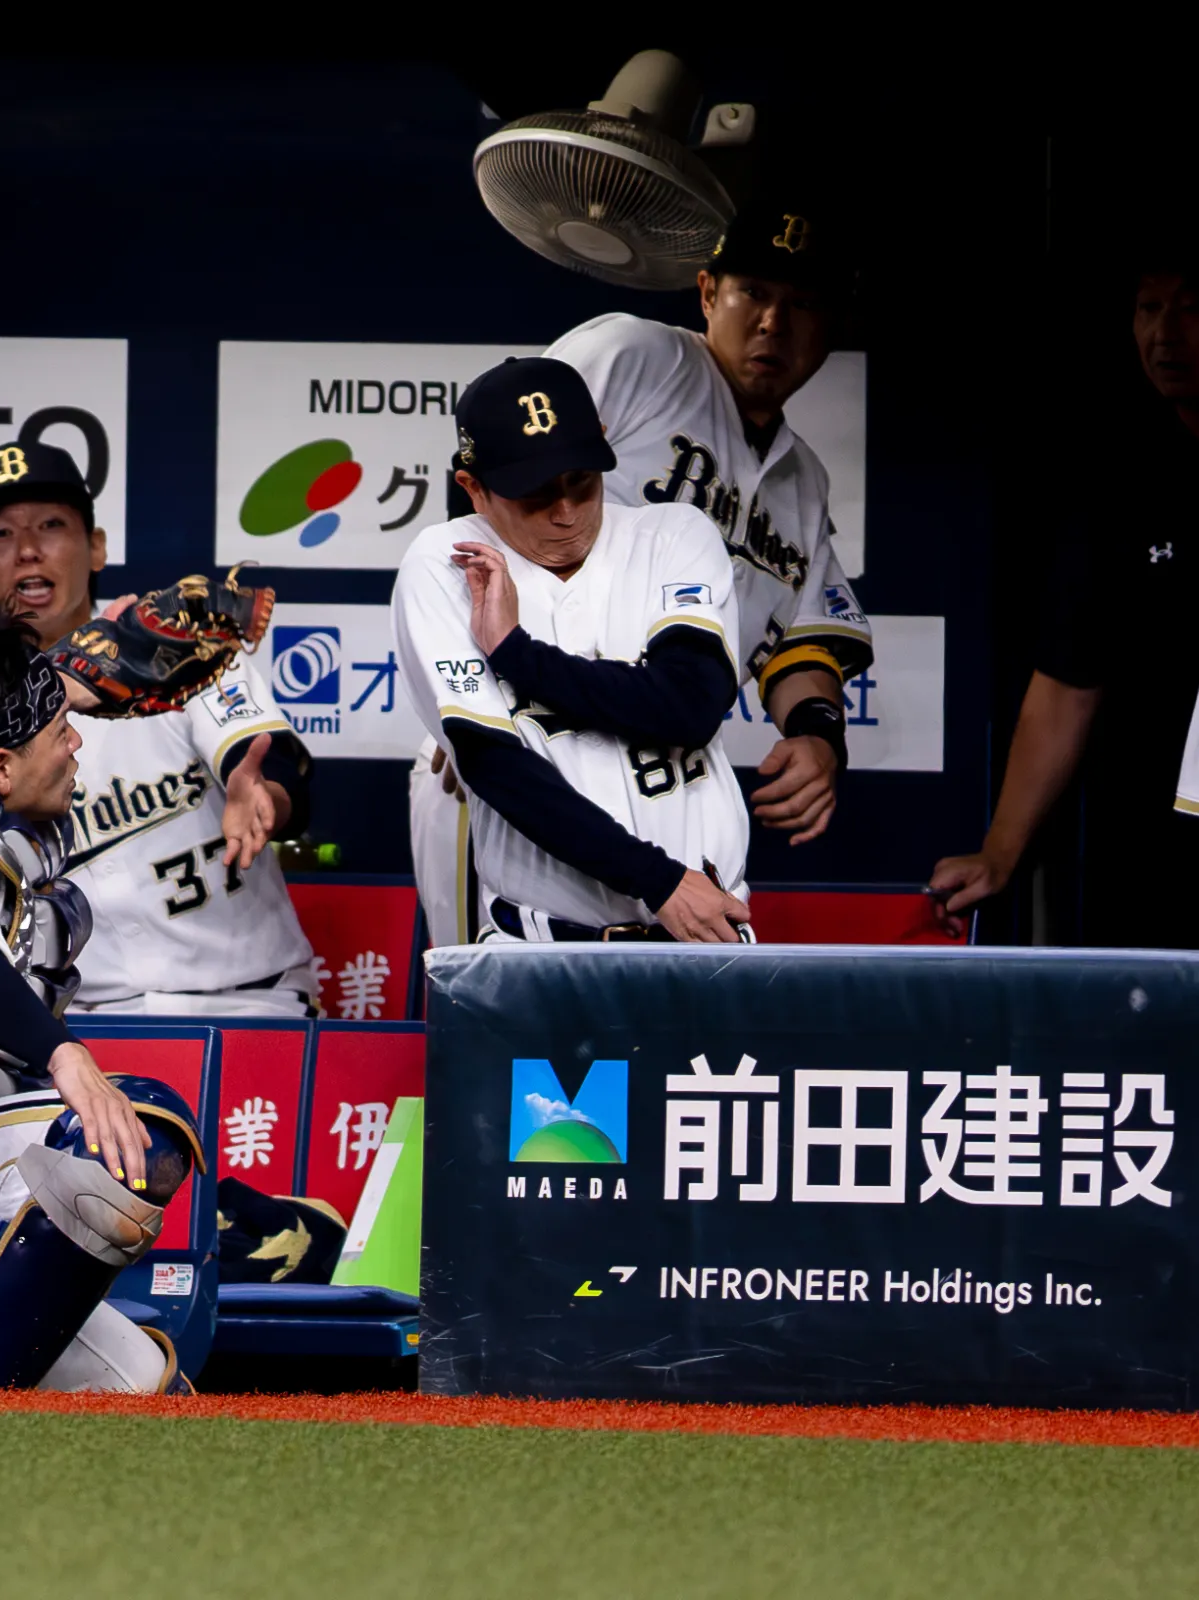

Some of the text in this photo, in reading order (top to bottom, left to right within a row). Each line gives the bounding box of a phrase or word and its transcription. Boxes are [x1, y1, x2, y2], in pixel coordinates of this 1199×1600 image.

[309, 379, 474, 415] MIDORI
[518, 391, 557, 436] B
[436, 659, 485, 676] FWD
[150, 834, 248, 920] 37
[223, 1096, 279, 1169] 業
[663, 1053, 1175, 1207] 前田建設
[507, 1176, 628, 1200] MAEDA
[659, 1265, 1103, 1314] INFRONEER Holdings Inc.
